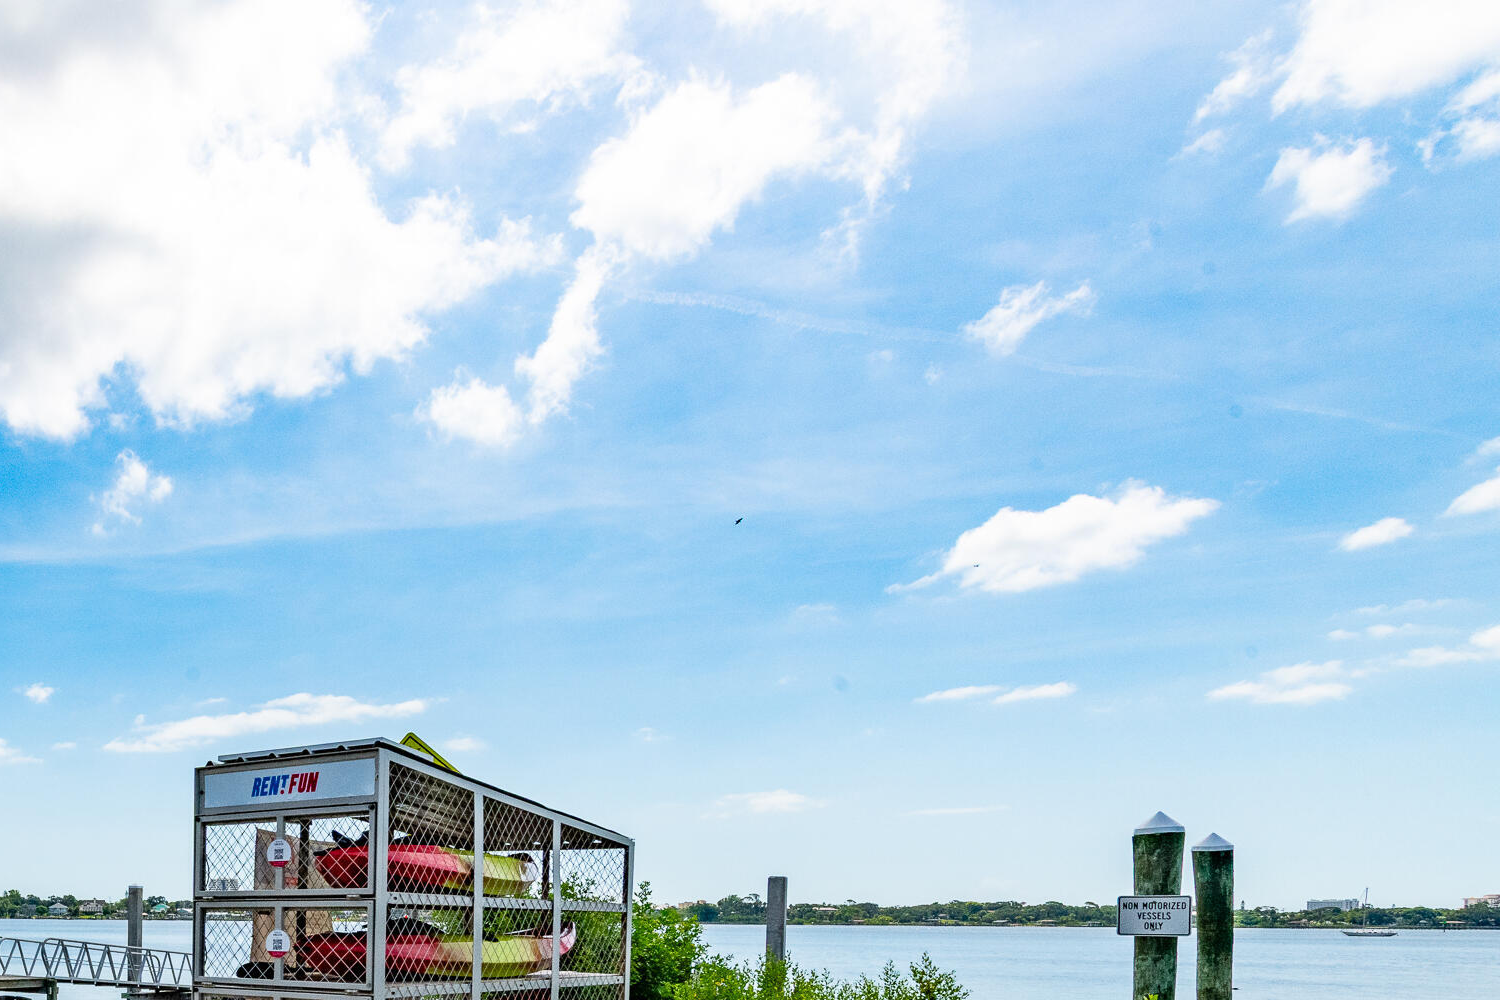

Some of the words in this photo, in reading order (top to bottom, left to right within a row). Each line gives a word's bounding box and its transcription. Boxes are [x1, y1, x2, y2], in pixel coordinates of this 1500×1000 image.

[1122, 902, 1139, 910] NON
[1142, 902, 1187, 910] MOTORIZED
[1137, 912, 1171, 920] VESSELS
[1144, 922, 1164, 930] ONLY
